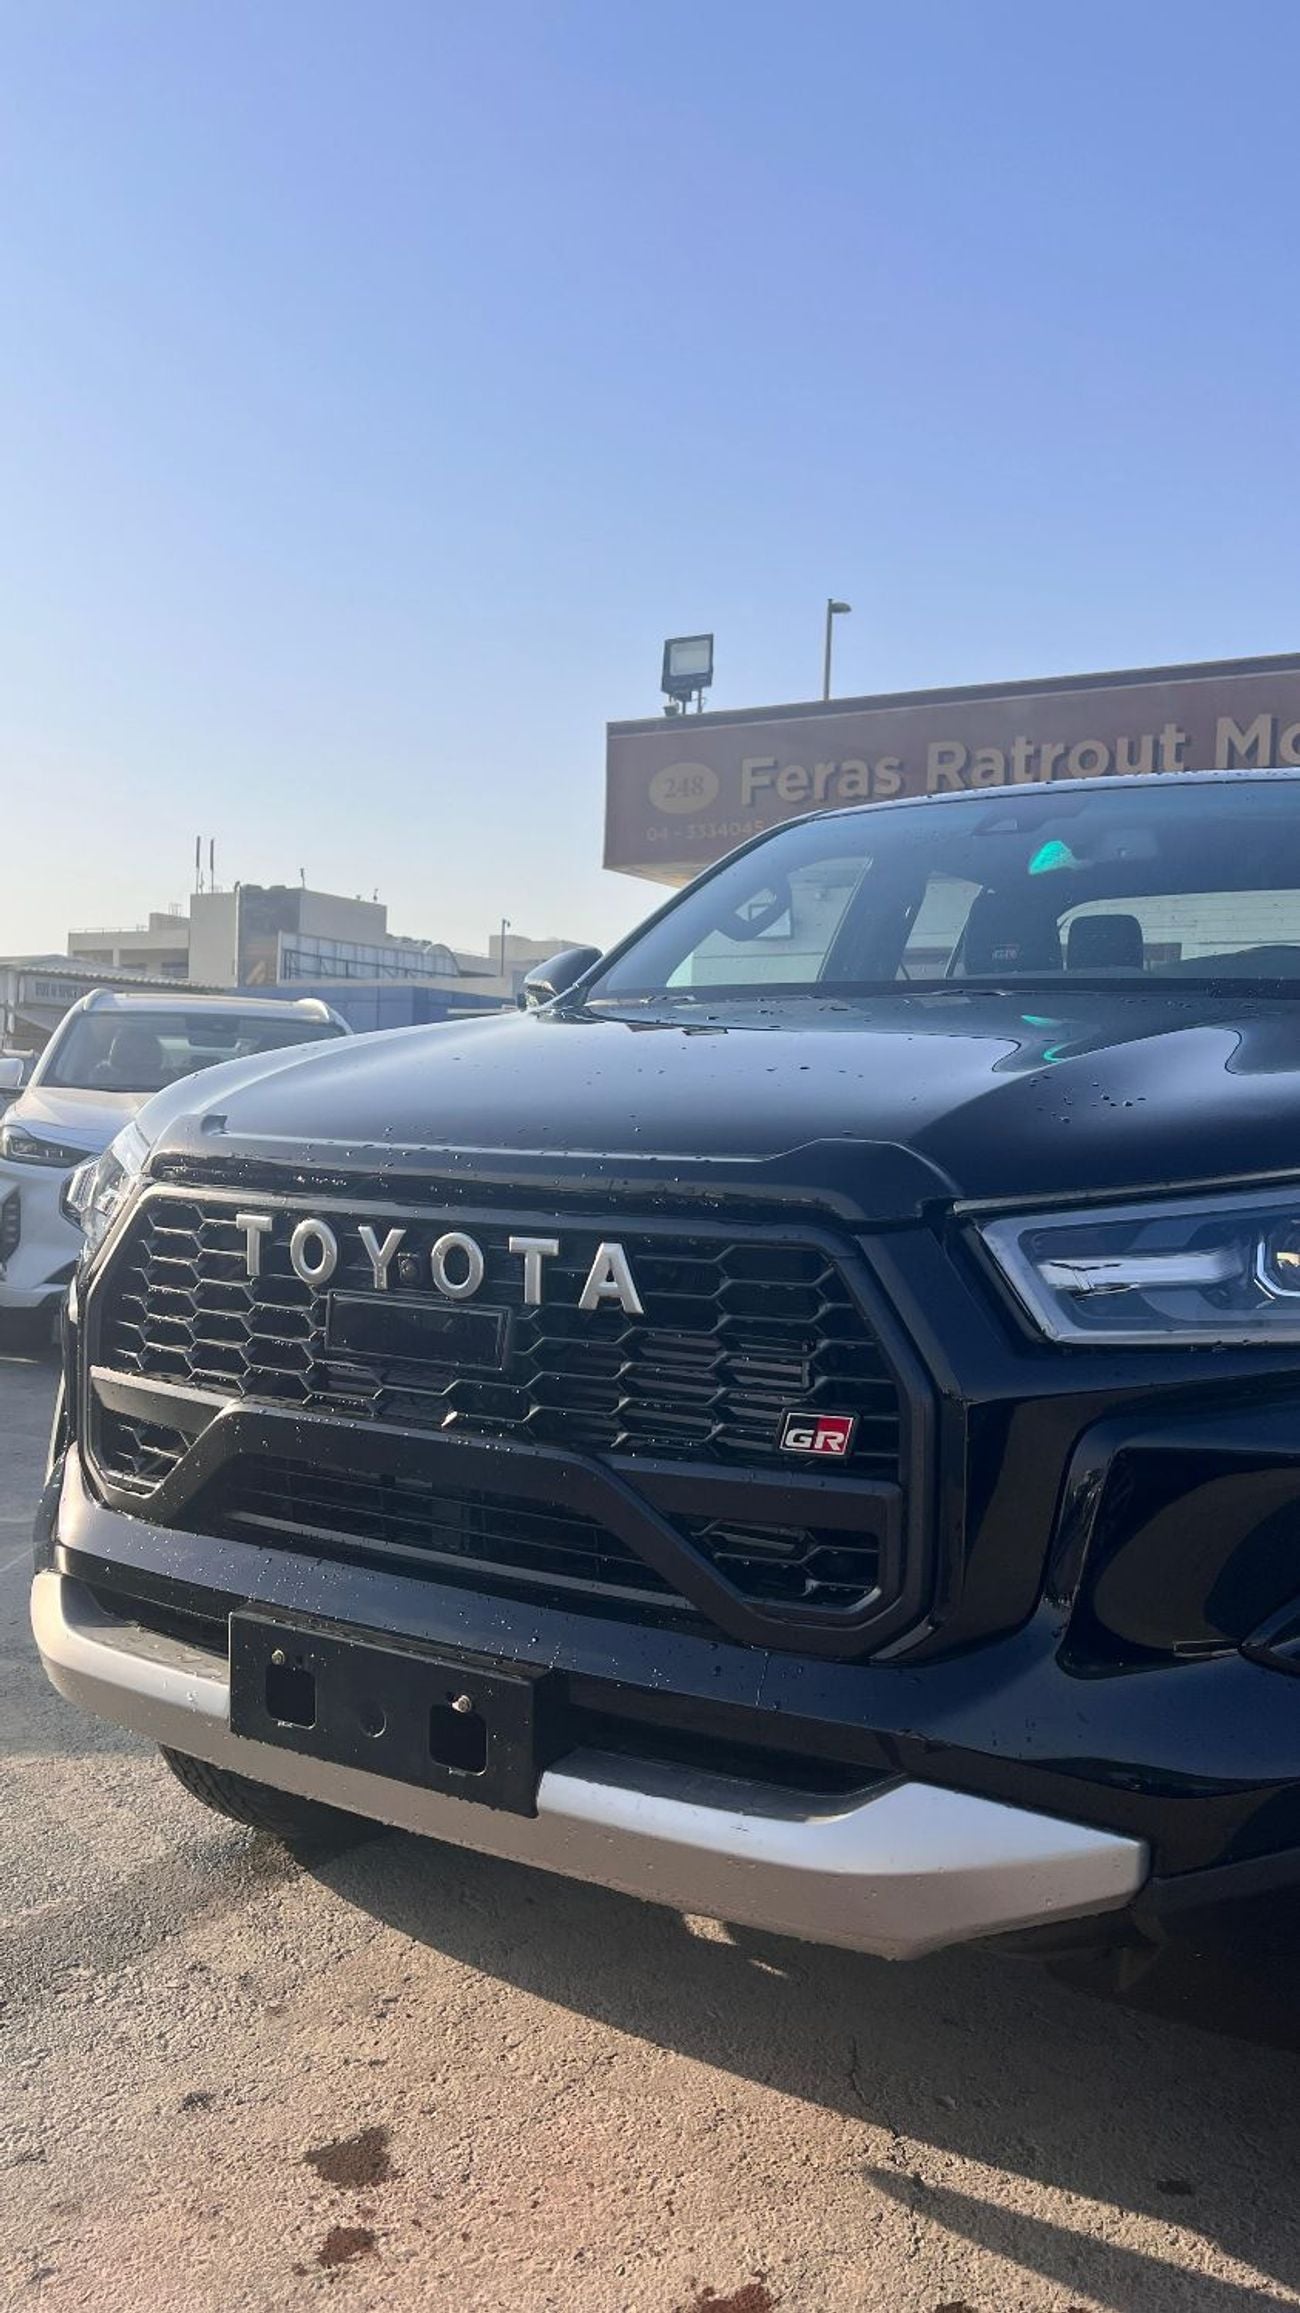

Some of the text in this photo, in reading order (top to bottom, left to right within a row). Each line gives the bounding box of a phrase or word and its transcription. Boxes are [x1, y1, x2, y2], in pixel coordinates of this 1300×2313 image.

[664, 775, 705, 798] 248
[741, 756, 902, 805] Feras
[926, 723, 1187, 792] Ratrout
[236, 1213, 645, 1315] TOYOTA
[785, 1428, 846, 1451] GR
